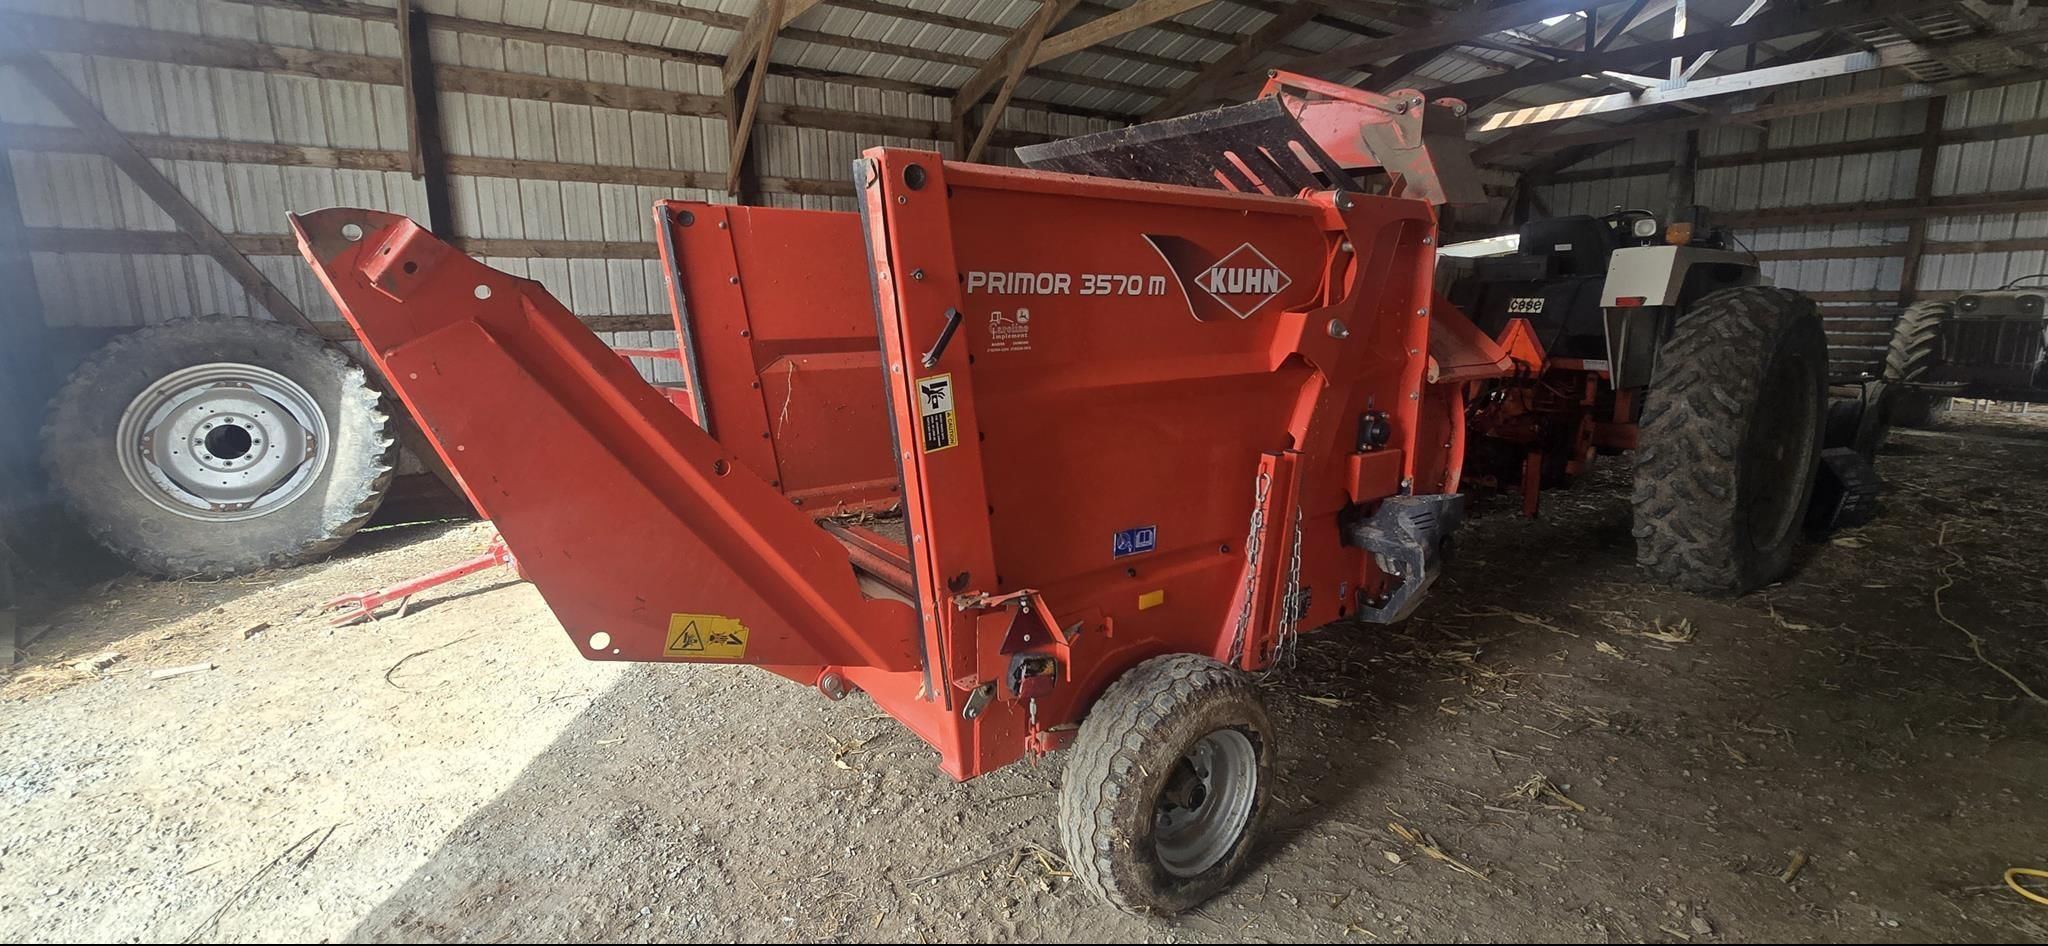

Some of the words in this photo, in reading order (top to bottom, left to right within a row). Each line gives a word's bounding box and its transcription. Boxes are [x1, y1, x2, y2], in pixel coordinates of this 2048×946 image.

[967, 271, 1072, 295] PRIMOR
[1080, 274, 1143, 296] 3570
[1210, 267, 1279, 293] KUHN
